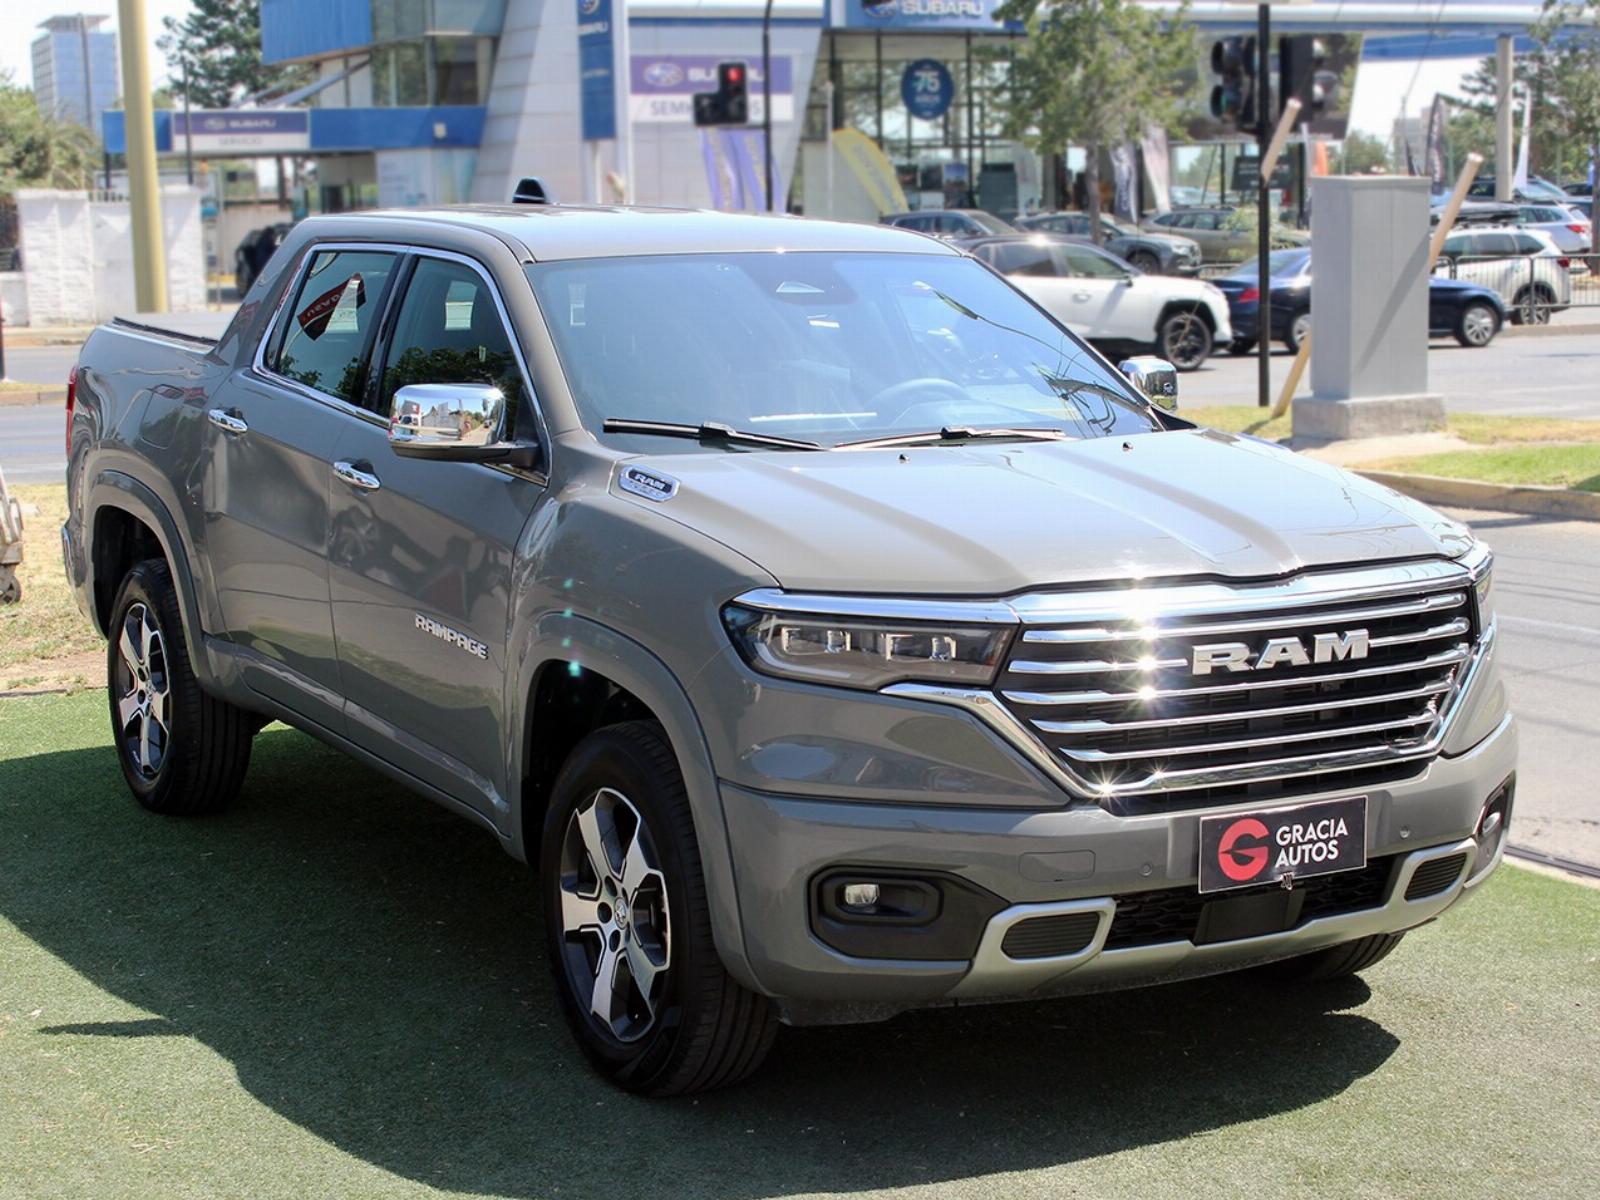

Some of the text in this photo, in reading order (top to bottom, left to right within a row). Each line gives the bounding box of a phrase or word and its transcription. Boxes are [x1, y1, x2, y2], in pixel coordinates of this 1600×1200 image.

[901, 0, 984, 16] SUBARU
[913, 70, 940, 92] 75
[634, 473, 665, 490] RAM
[415, 613, 488, 659] RAMPAGE
[1192, 628, 1369, 675] RAM
[1275, 817, 1348, 847] GRACIA
[1274, 838, 1339, 868] AUTOS
